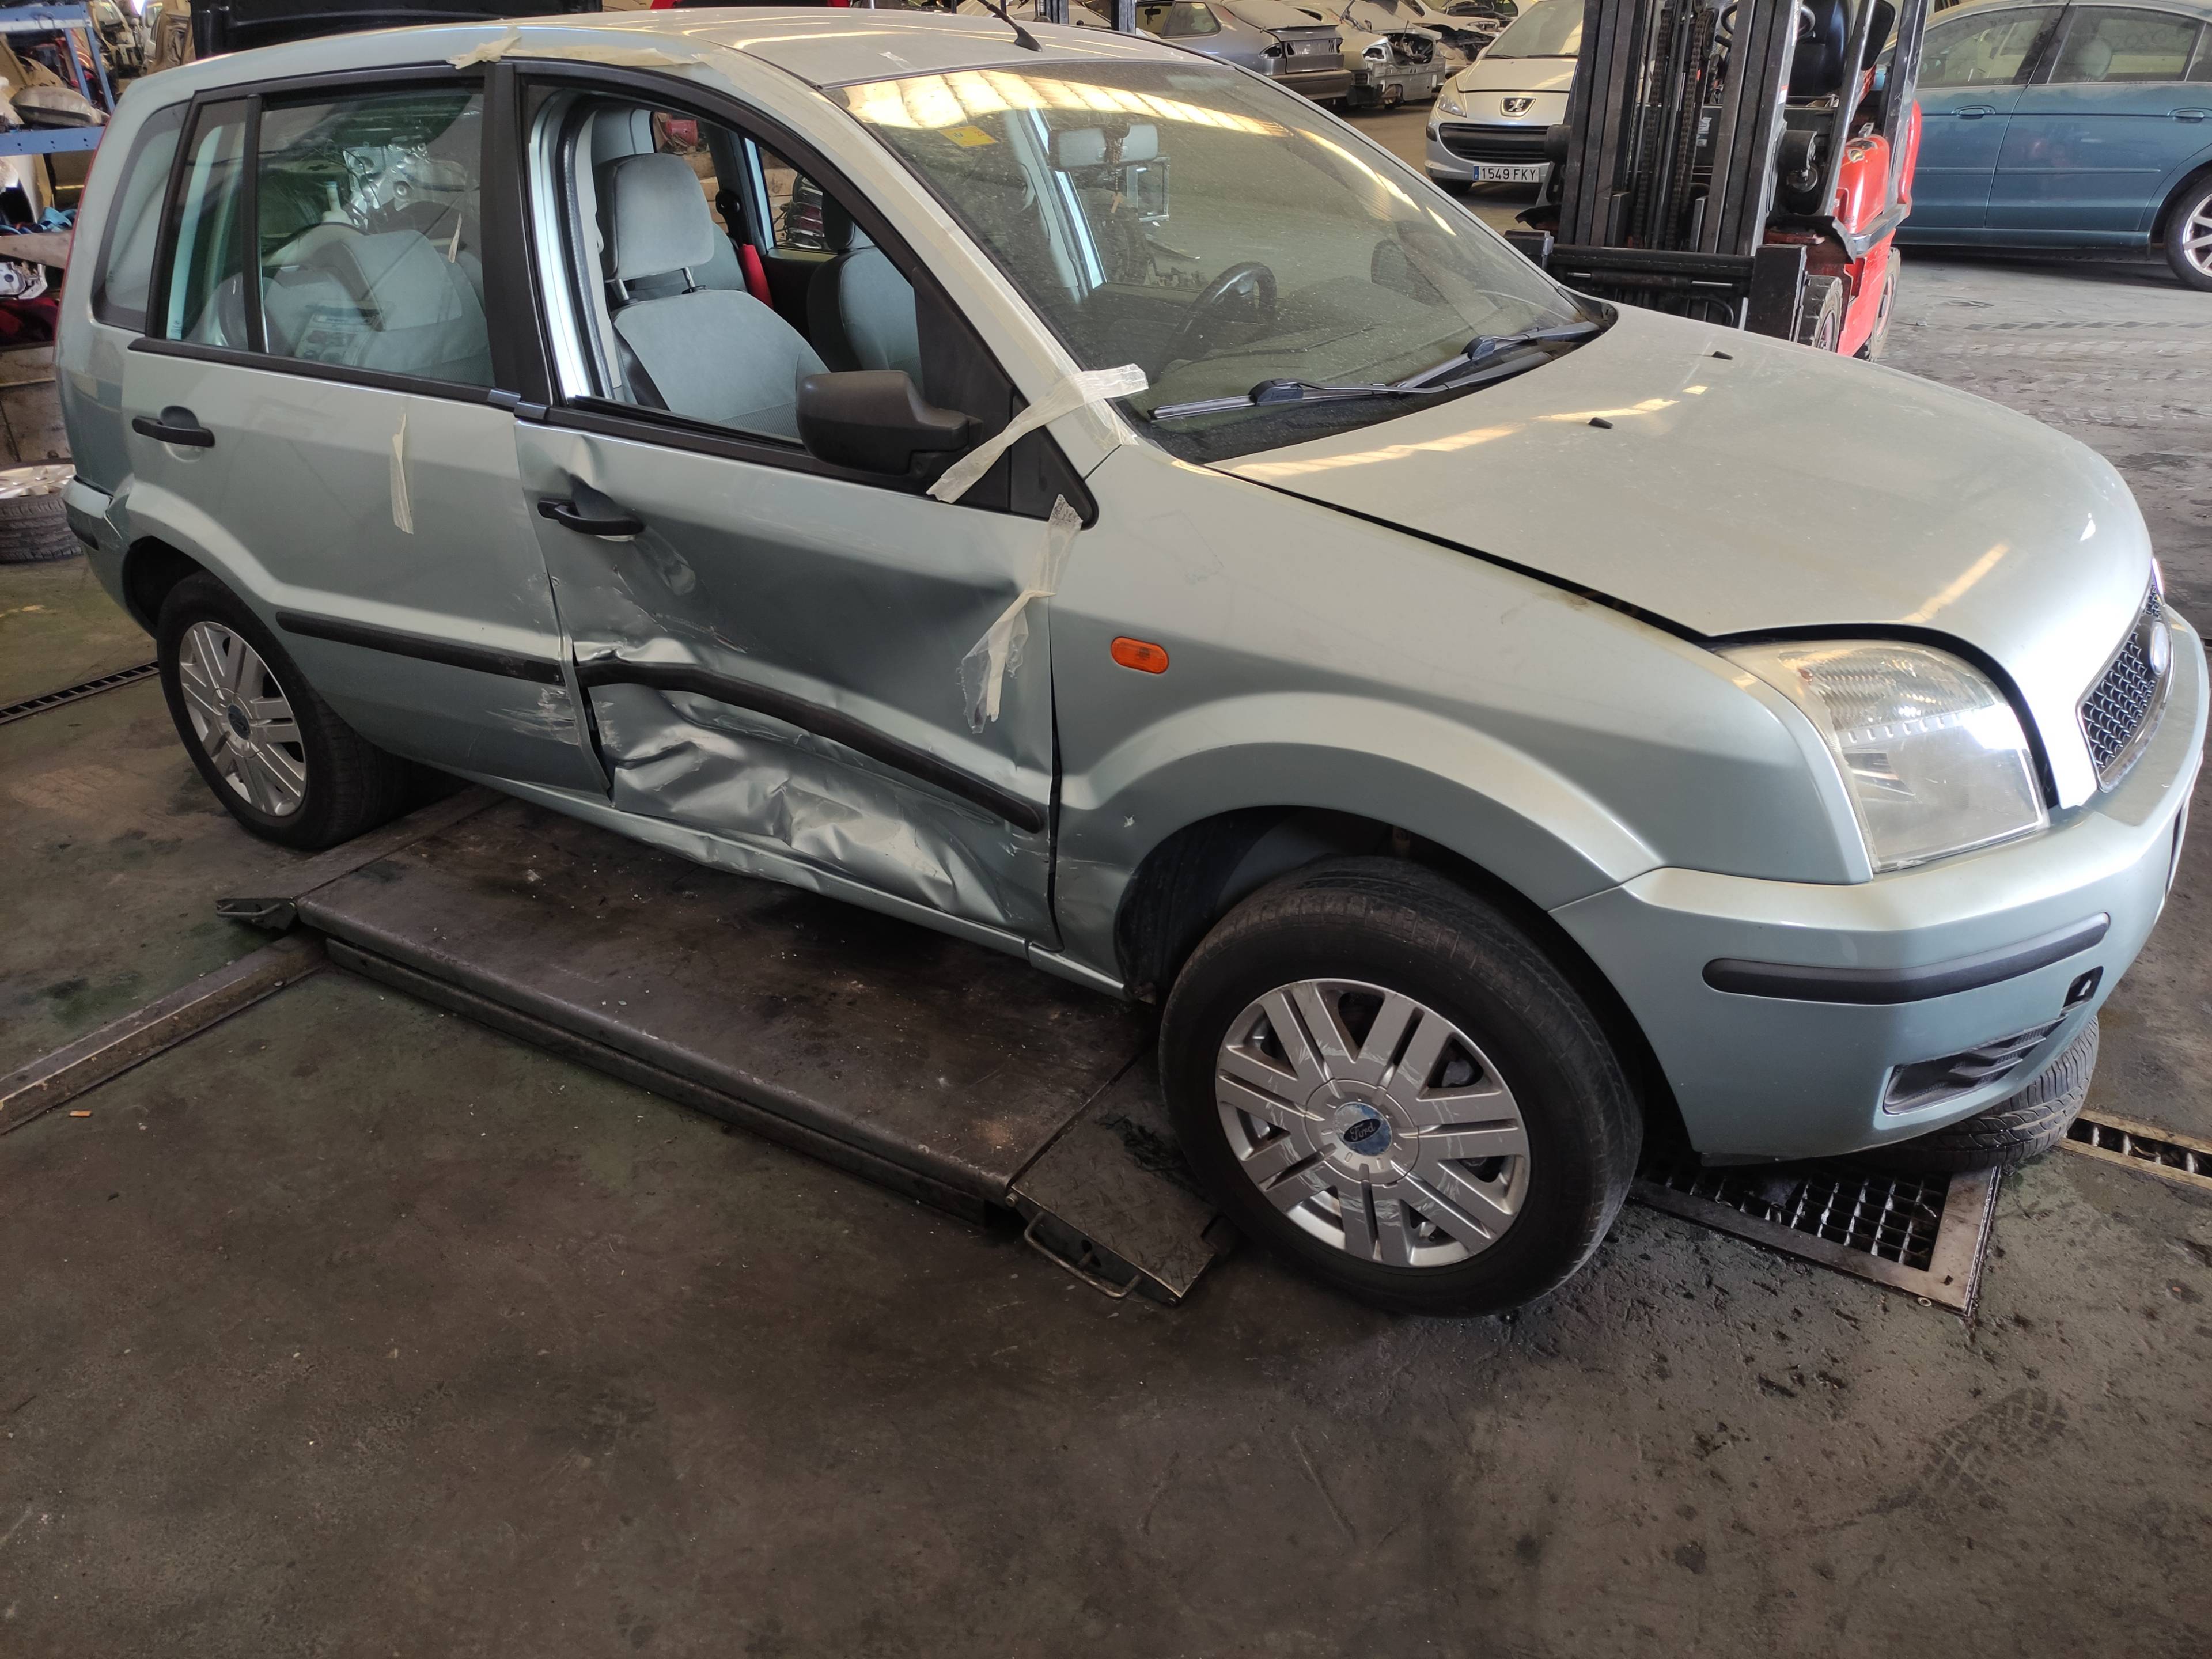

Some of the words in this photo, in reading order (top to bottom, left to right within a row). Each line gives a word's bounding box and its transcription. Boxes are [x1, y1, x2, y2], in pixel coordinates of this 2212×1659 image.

[1482, 168, 1509, 180] 1549
[1513, 169, 1536, 181] FKY
[1350, 1121, 1376, 1141] Ford
